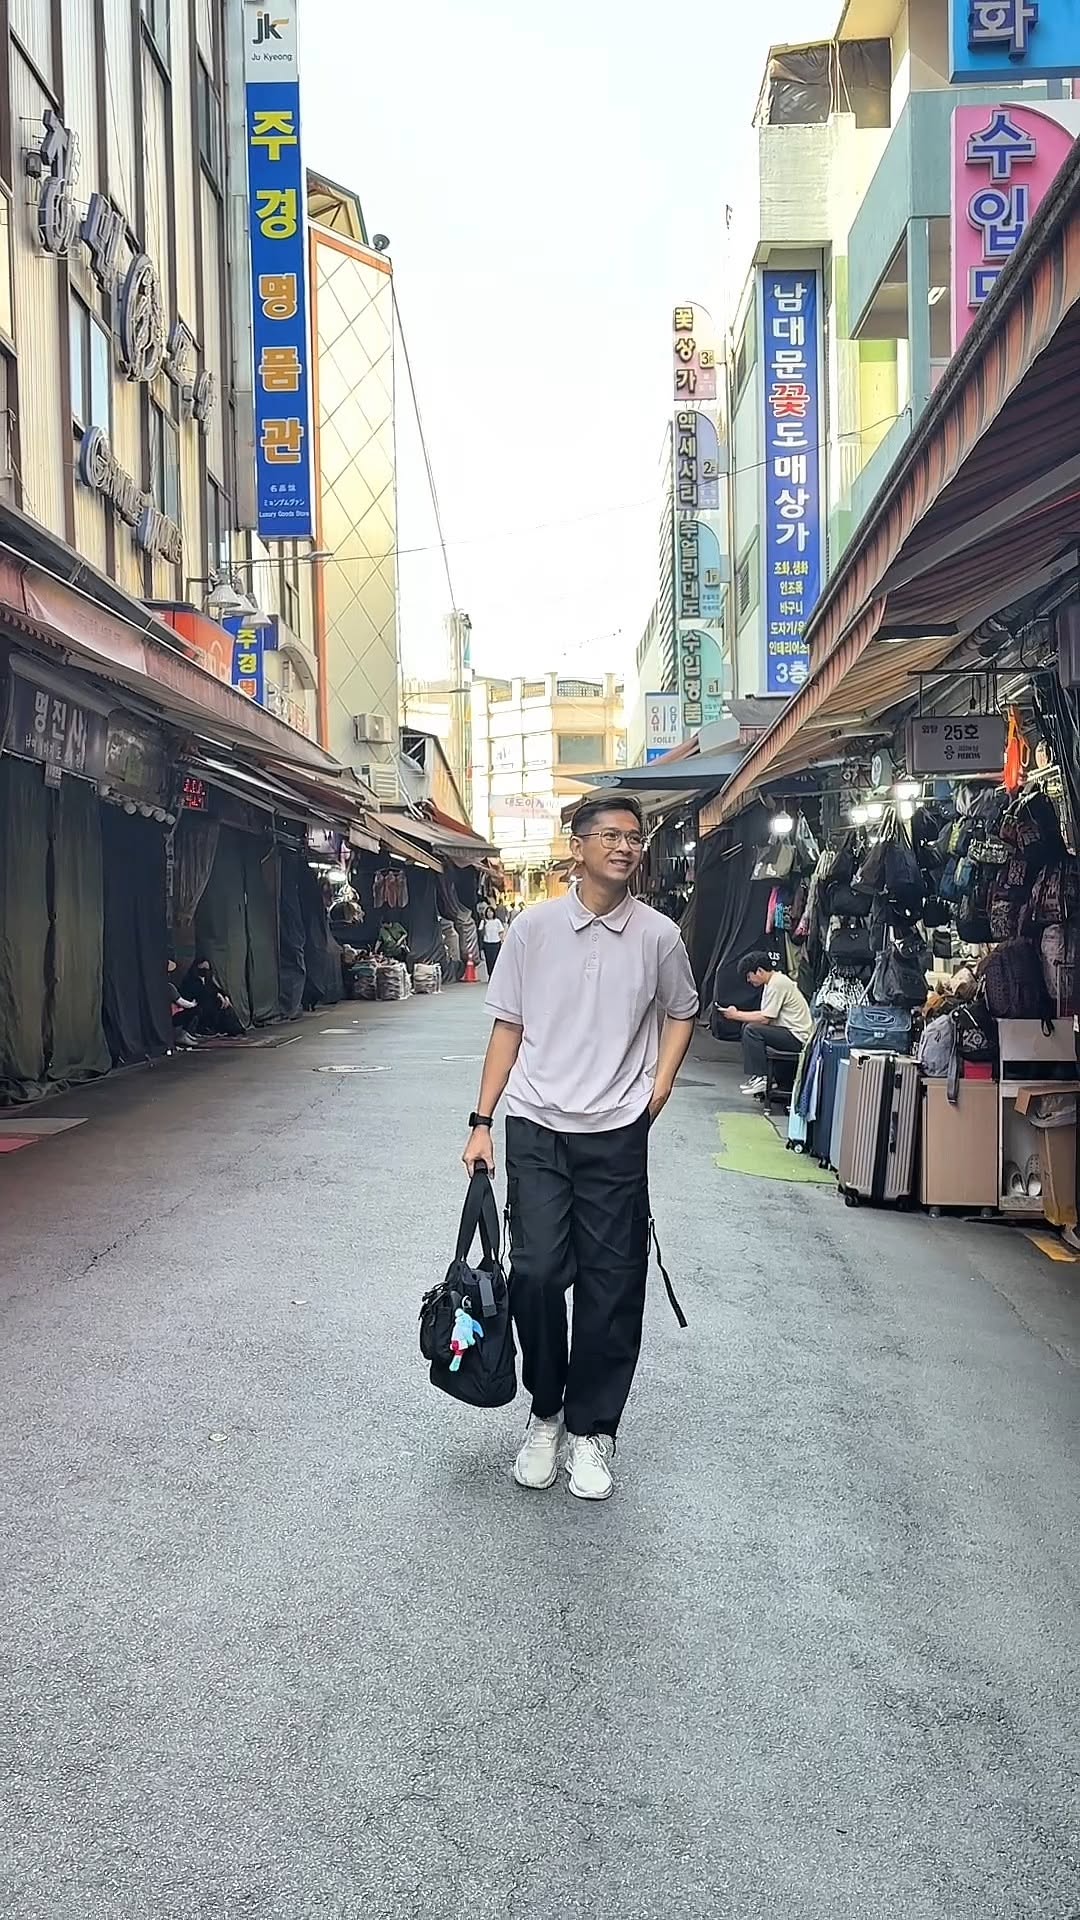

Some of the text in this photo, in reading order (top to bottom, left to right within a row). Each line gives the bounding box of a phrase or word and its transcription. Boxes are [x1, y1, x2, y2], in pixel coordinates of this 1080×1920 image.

[252, 52, 293, 62] Ju Kyeong
[780, 601, 804, 616] 바구니
[682, 630, 702, 726] 수입명품
[943, 724, 980, 741] 25호
